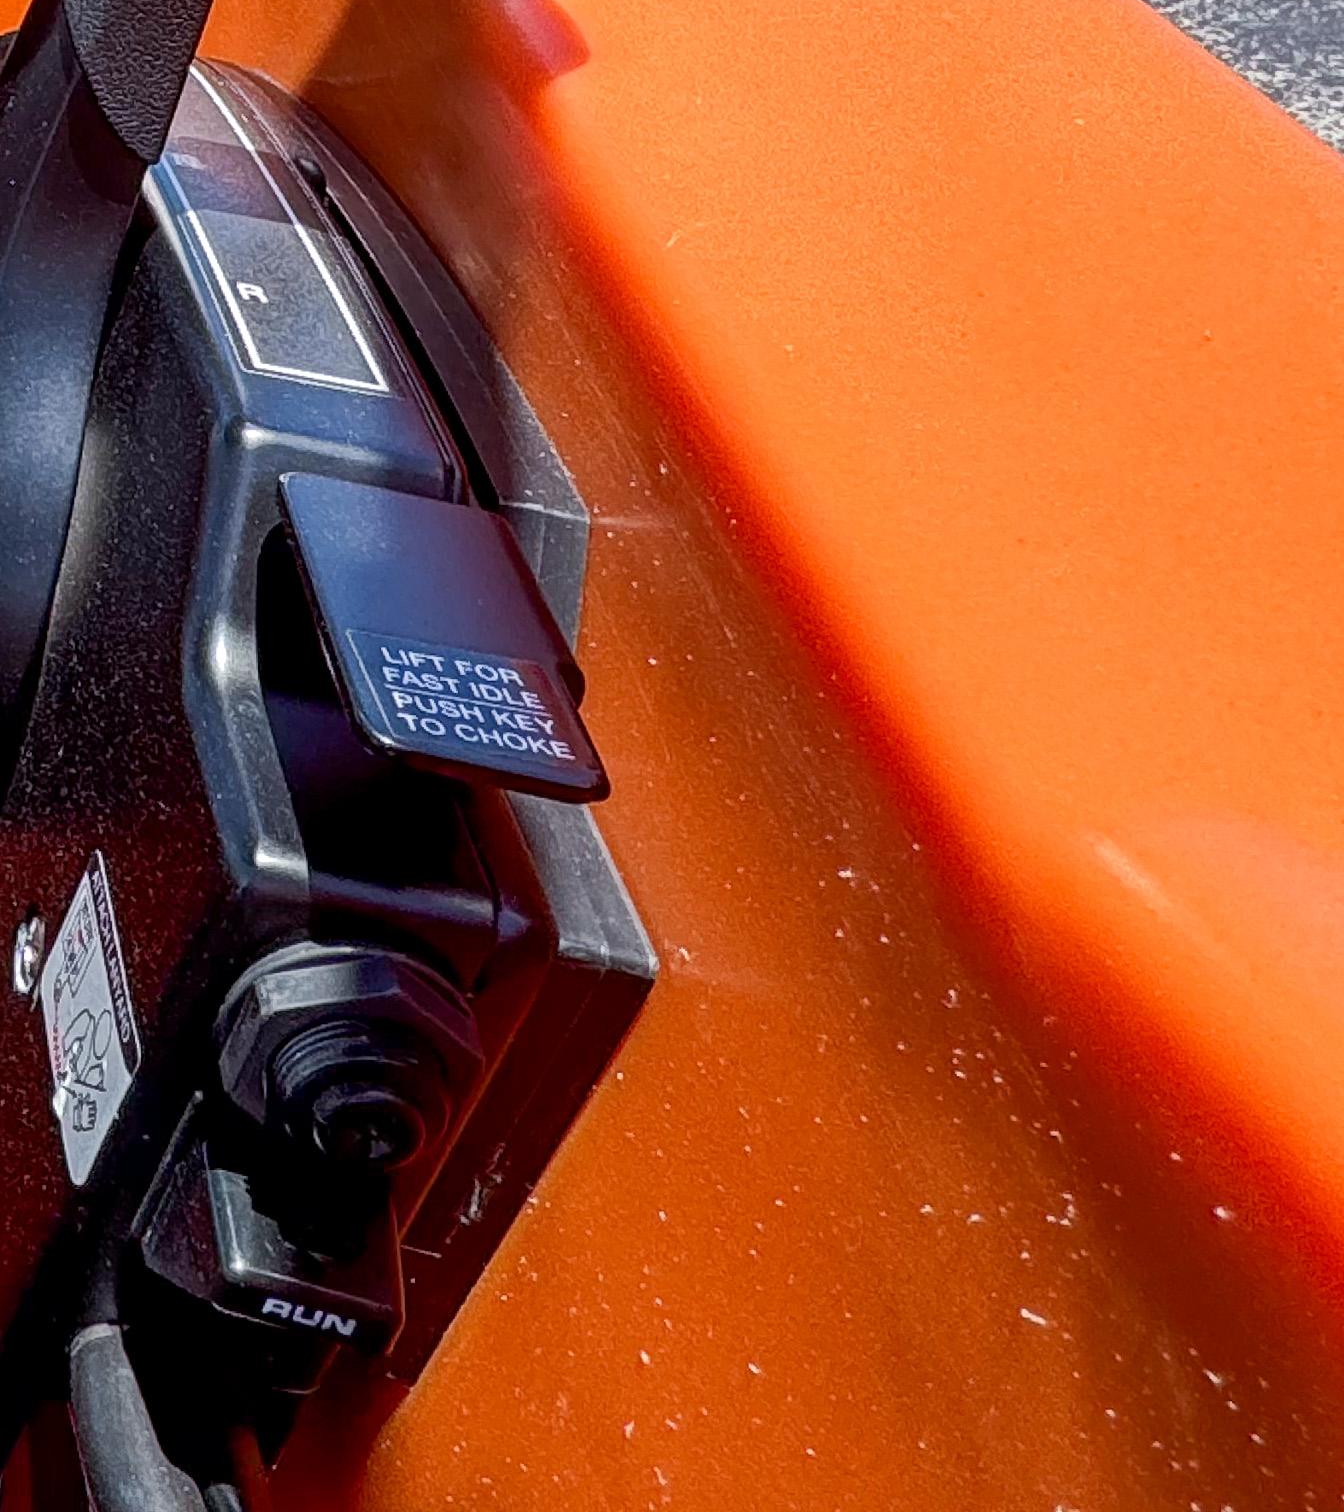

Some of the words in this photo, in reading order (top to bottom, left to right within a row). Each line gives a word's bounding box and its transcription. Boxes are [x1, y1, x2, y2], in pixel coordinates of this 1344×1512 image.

[235, 280, 269, 304] R
[380, 645, 445, 672] LIFT
[453, 659, 525, 687] FOR
[382, 665, 461, 694] FAST
[467, 680, 547, 711] IDLE
[391, 690, 486, 724] PUSH
[490, 708, 554, 736] KEY
[396, 711, 447, 737] TO
[454, 723, 577, 761] CHOKE
[261, 1296, 358, 1337] RUN
